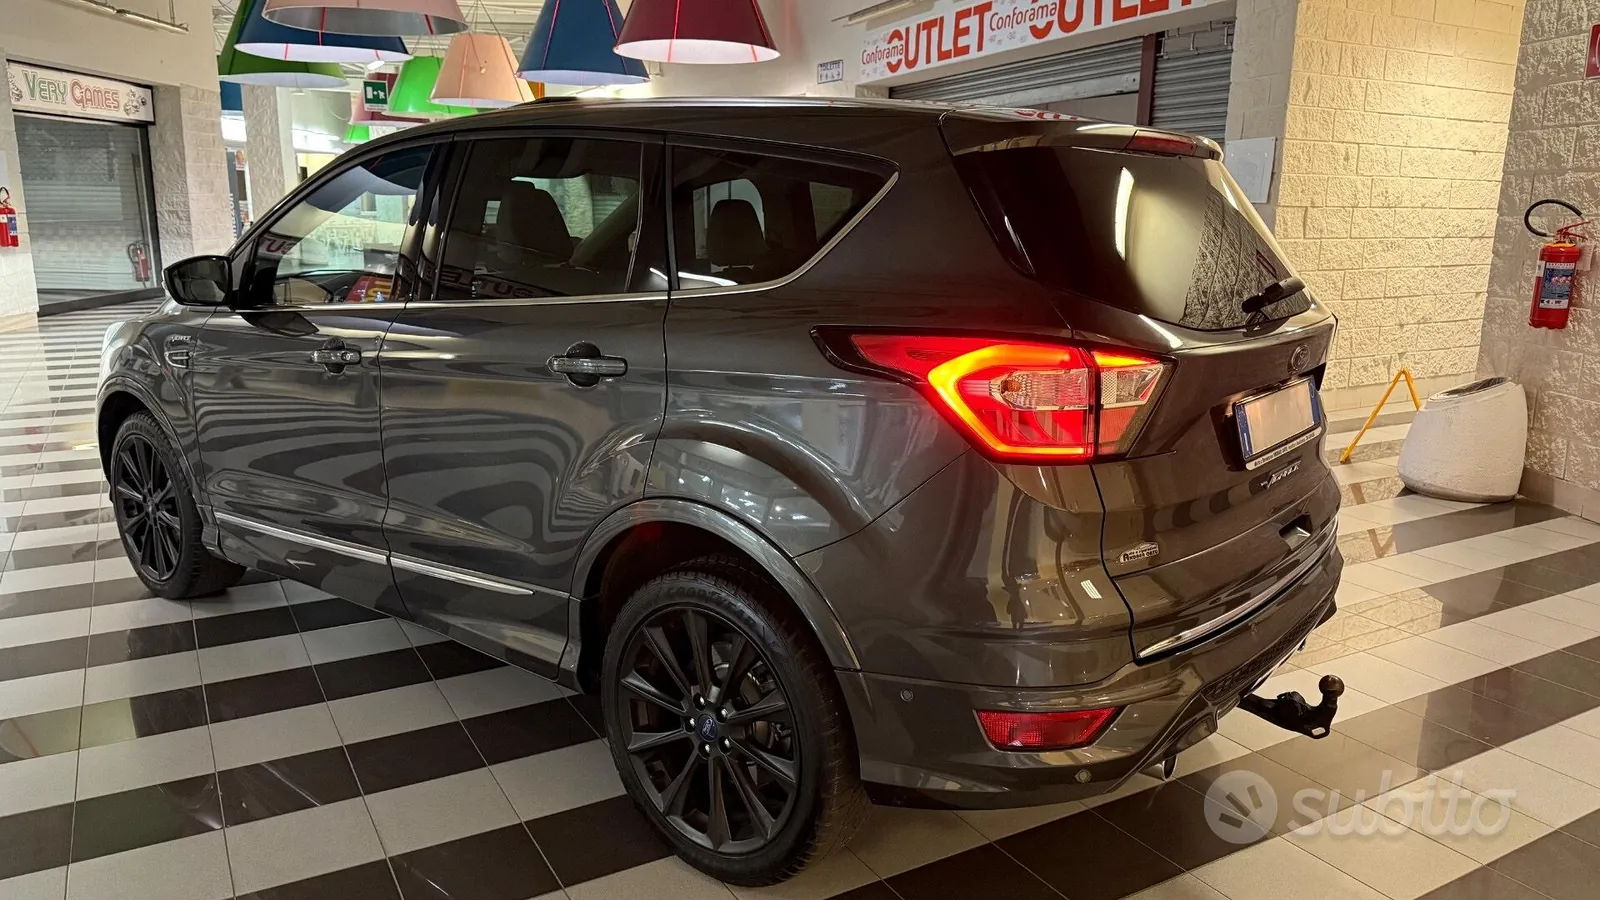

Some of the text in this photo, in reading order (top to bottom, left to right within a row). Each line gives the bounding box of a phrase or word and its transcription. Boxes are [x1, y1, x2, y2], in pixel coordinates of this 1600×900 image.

[861, 43, 904, 65] Conforama
[886, 1, 993, 73] OUTLET
[989, 2, 1057, 31] Conforama
[22, 70, 120, 111] VERY GAMES
